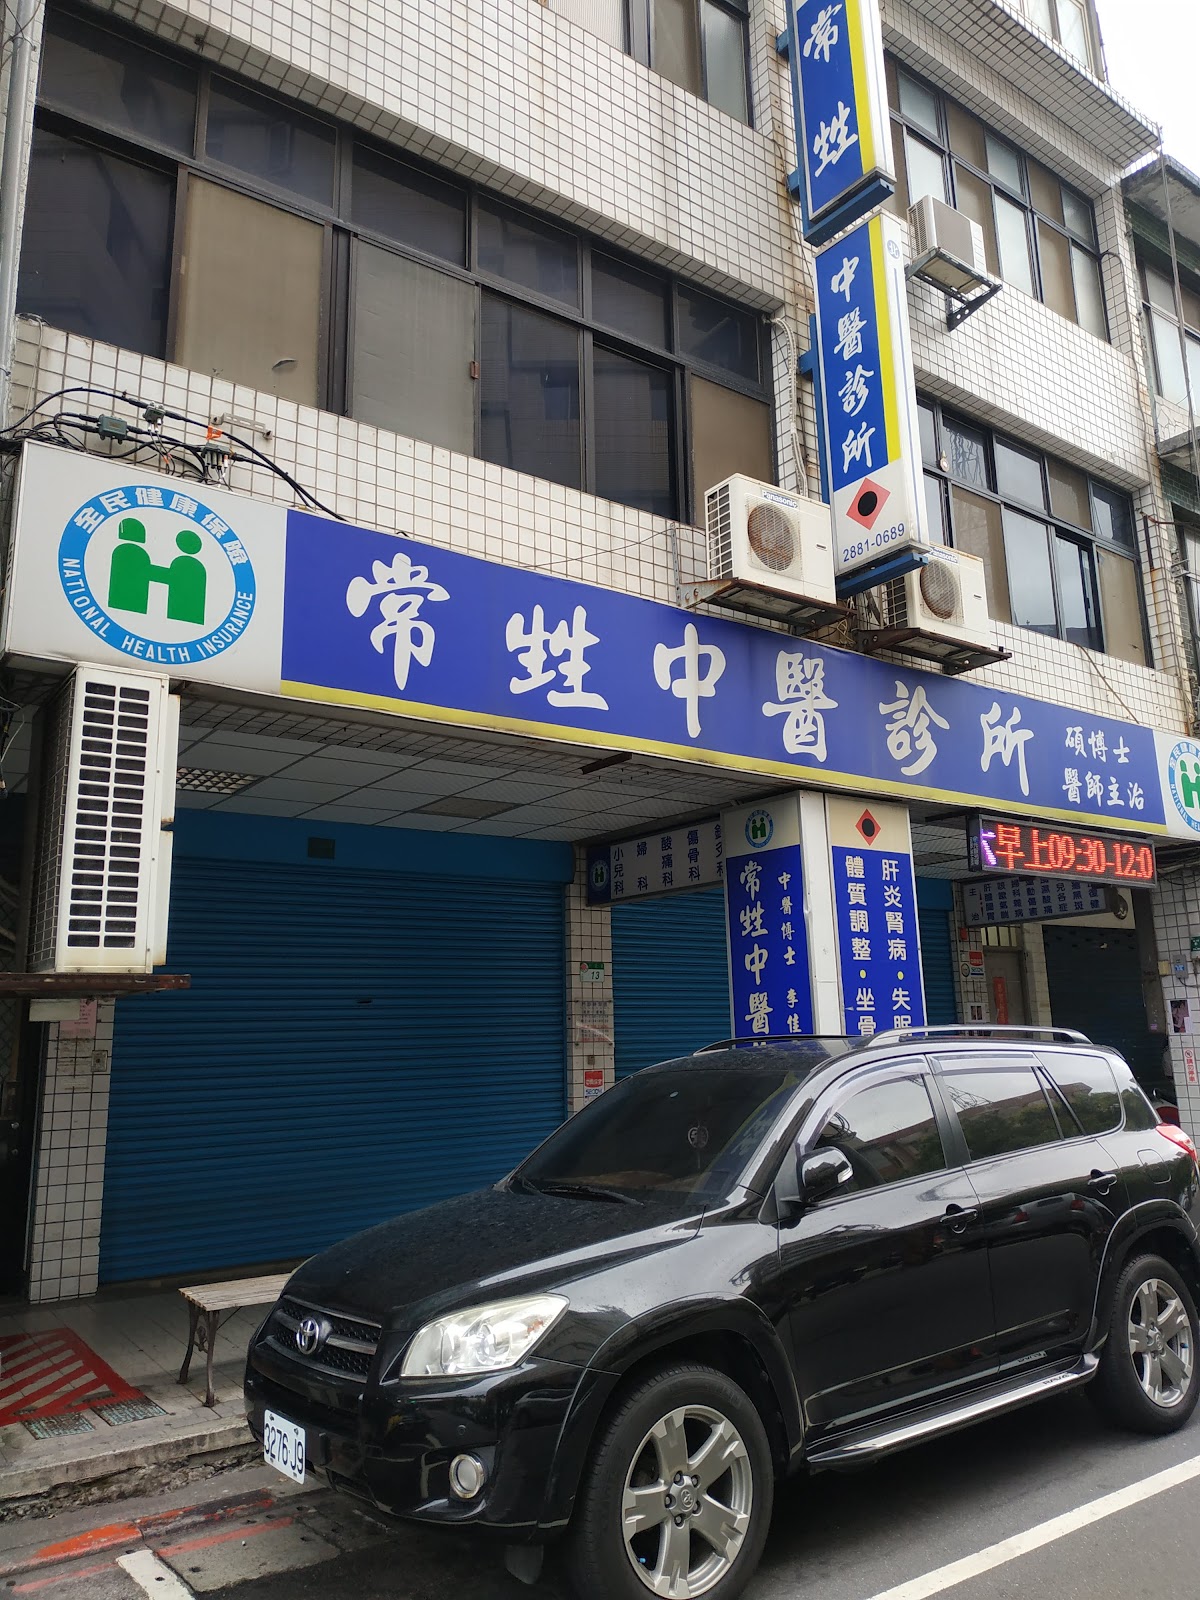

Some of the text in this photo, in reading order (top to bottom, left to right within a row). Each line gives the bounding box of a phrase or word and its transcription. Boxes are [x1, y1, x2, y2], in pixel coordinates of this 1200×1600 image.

[831, 256, 876, 474] 中醫診所
[762, 490, 798, 508] Panasonic
[74, 488, 249, 565] 全民健康保險
[843, 523, 905, 562] 2881-0689
[63, 558, 253, 663] NATIONAL HEALTH INSURANCE
[1065, 726, 1130, 763] 碩博士
[1062, 767, 1144, 810] 醫師主治
[1170, 783, 1189, 823] NATIONAL
[613, 847, 624, 895] 小兒科
[661, 836, 673, 887] 酸痛科
[687, 829, 700, 881] 傷骨科
[969, 888, 980, 921] 主治
[1056, 880, 1068, 912] 兒各症
[740, 860, 774, 1046] 常甡中醫
[591, 971, 600, 980] 13
